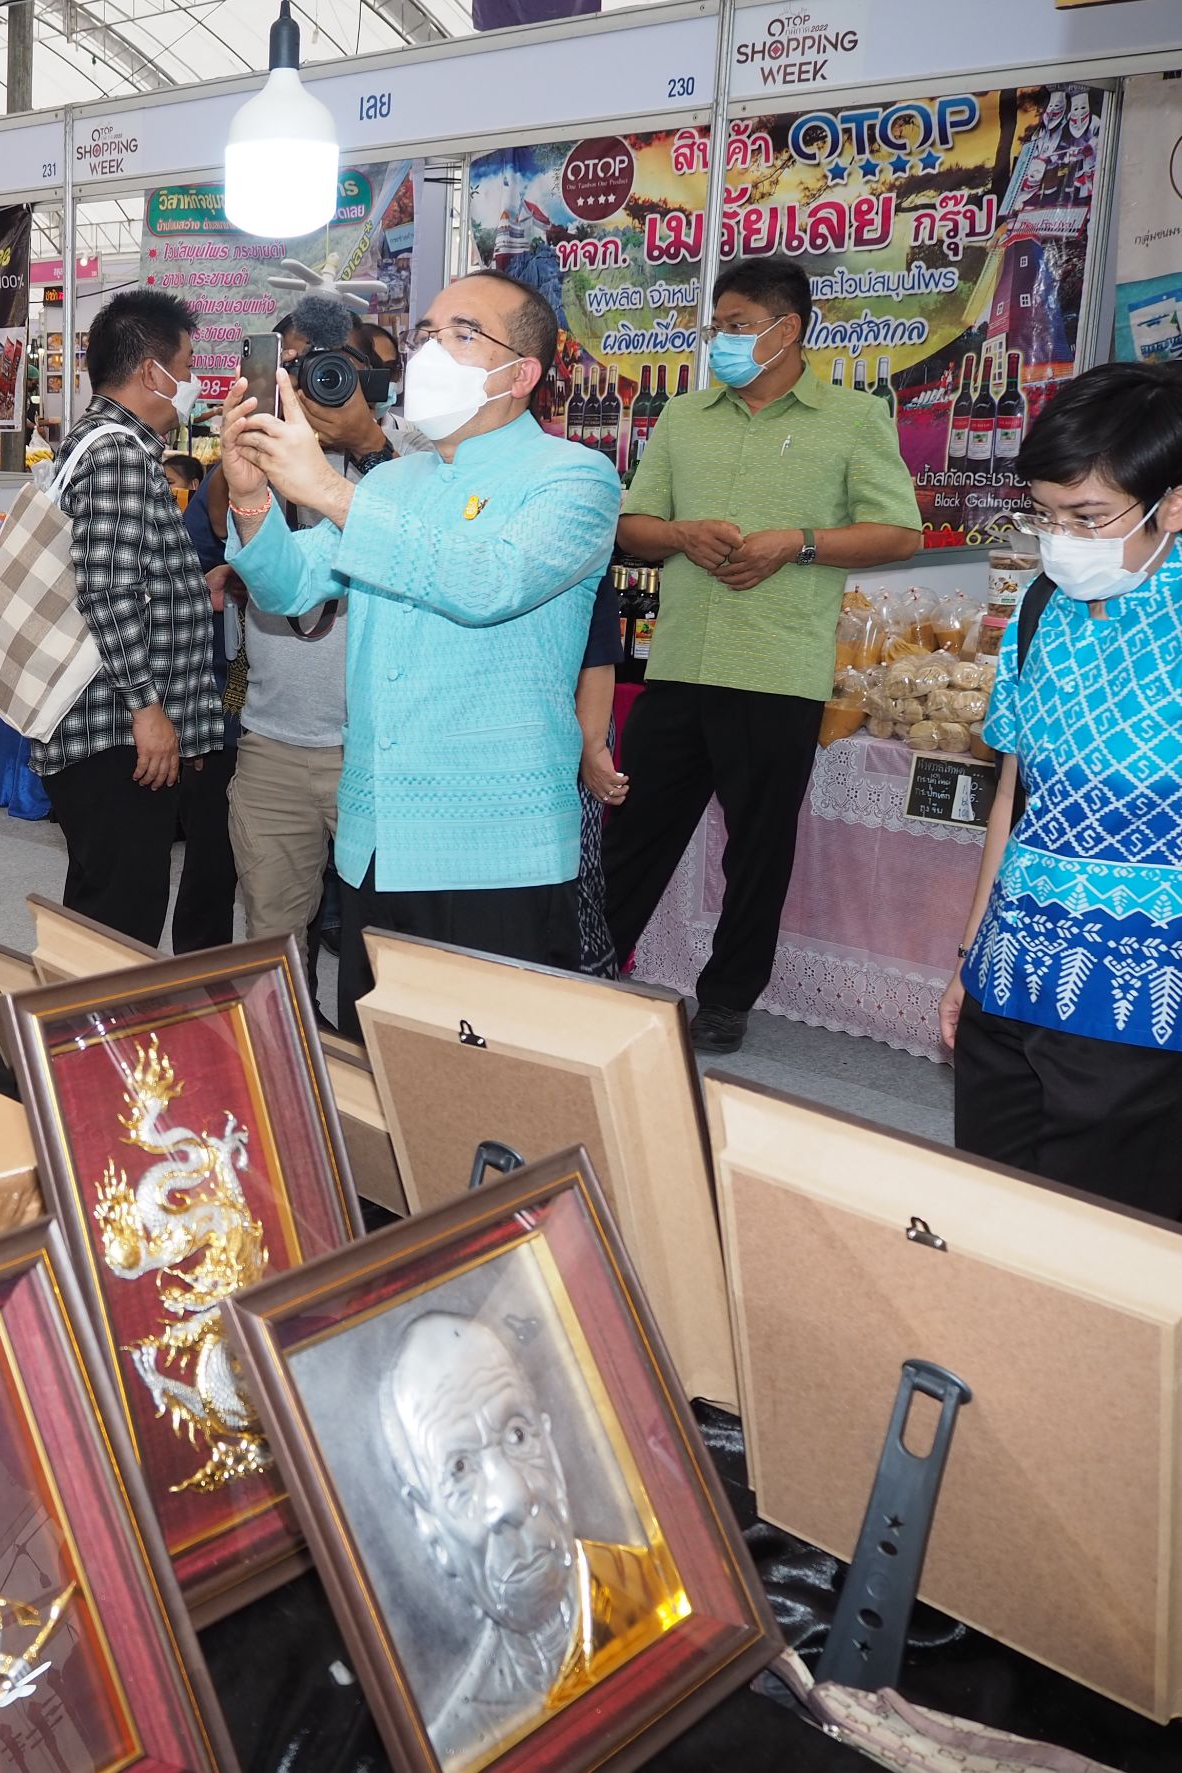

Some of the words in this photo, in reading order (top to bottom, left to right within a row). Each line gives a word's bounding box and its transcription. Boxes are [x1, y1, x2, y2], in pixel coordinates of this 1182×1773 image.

[768, 14, 811, 37] OTOP
[810, 24, 828, 33] 2022
[736, 30, 859, 64] SHOPPING
[760, 59, 829, 86] WEEK
[668, 77, 695, 98] 230
[359, 92, 392, 121] เลย
[789, 94, 979, 163] OTOP
[76, 138, 138, 161] SHOPPING
[42, 162, 57, 178] 231
[89, 158, 124, 176] WEEK
[567, 156, 629, 181] OTOP
[557, 235, 629, 271] หจก.
[912, 192, 996, 260] กรุ๊ป
[233, 239, 287, 260] กระชายดำ
[188, 267, 250, 287] กระชายดำ
[588, 282, 642, 316] ผู้ผลิต
[934, 491, 960, 507] Black
